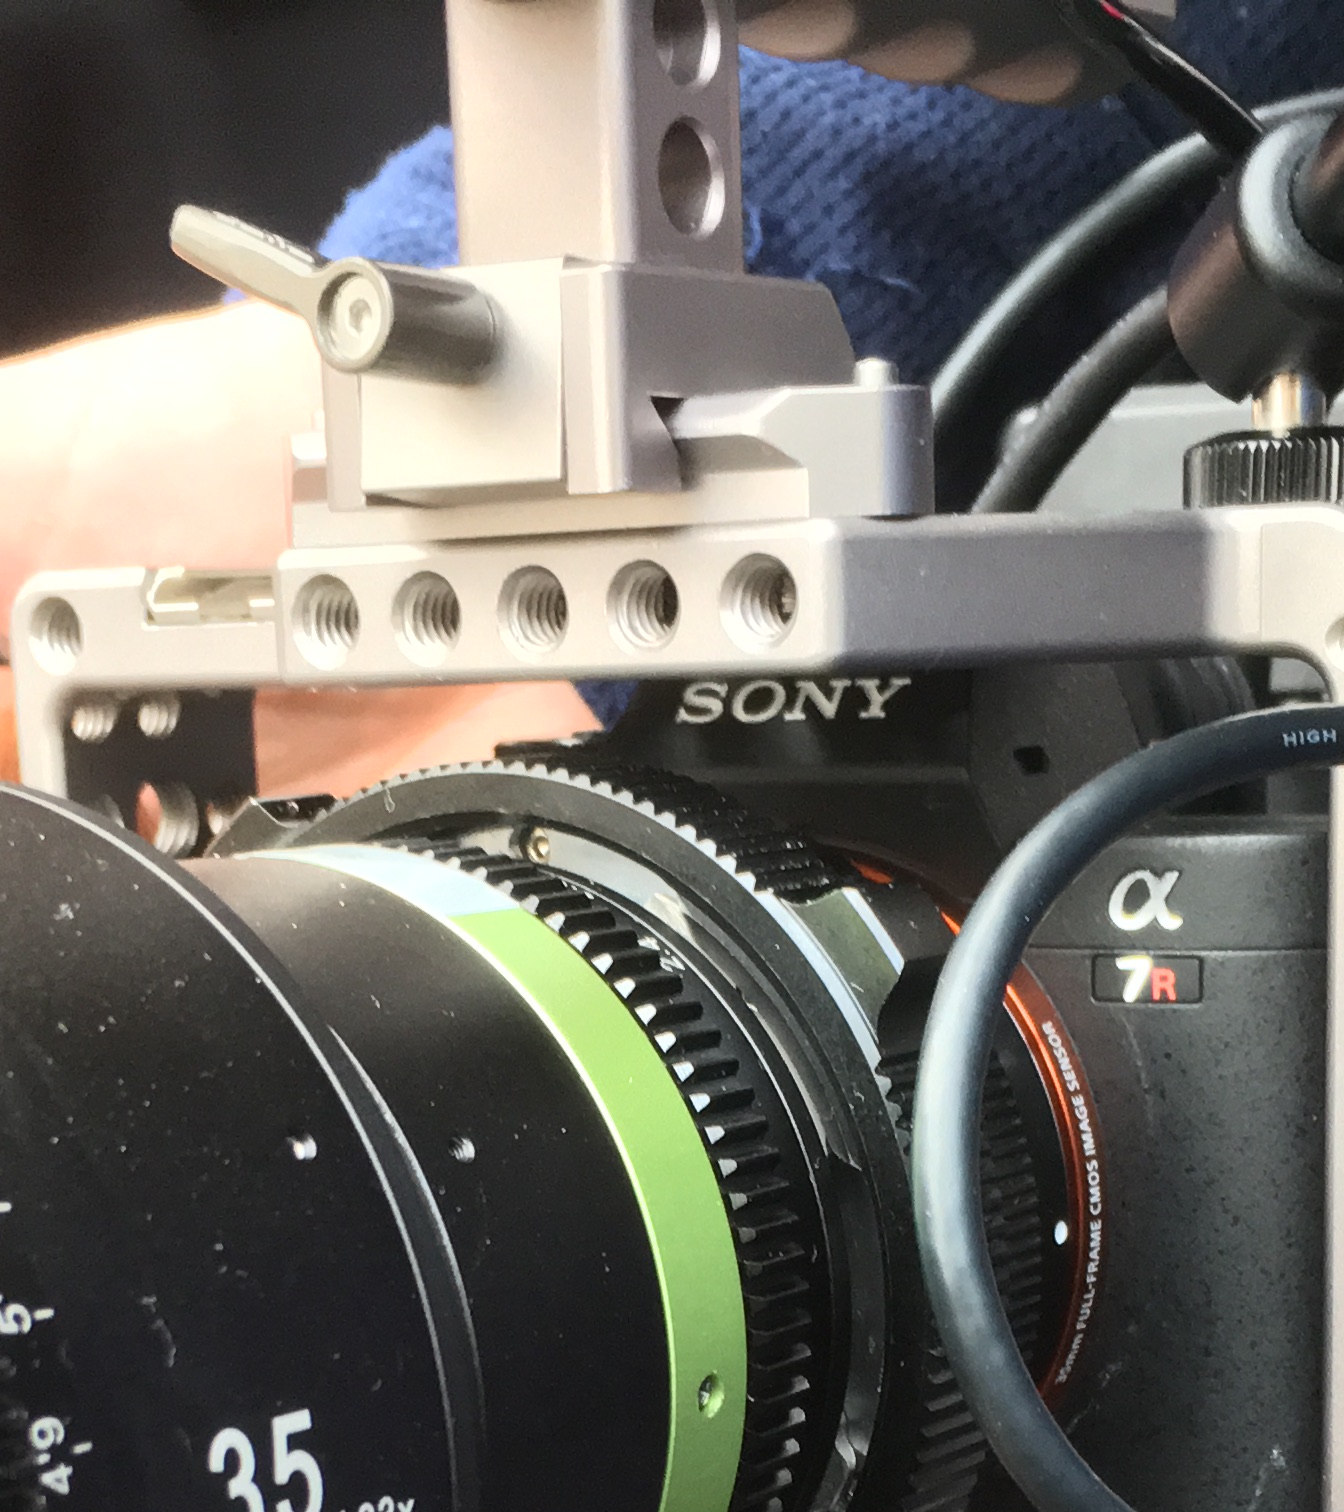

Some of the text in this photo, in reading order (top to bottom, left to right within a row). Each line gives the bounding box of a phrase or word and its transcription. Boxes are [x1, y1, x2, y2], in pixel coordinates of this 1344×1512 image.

[675, 676, 912, 724] SONY
[1282, 728, 1337, 748] HIGH
[1041, 1020, 1081, 1093] SENSOR
[1071, 1094, 1097, 1157] IMAGE
[1086, 1159, 1102, 1216] CMOS
